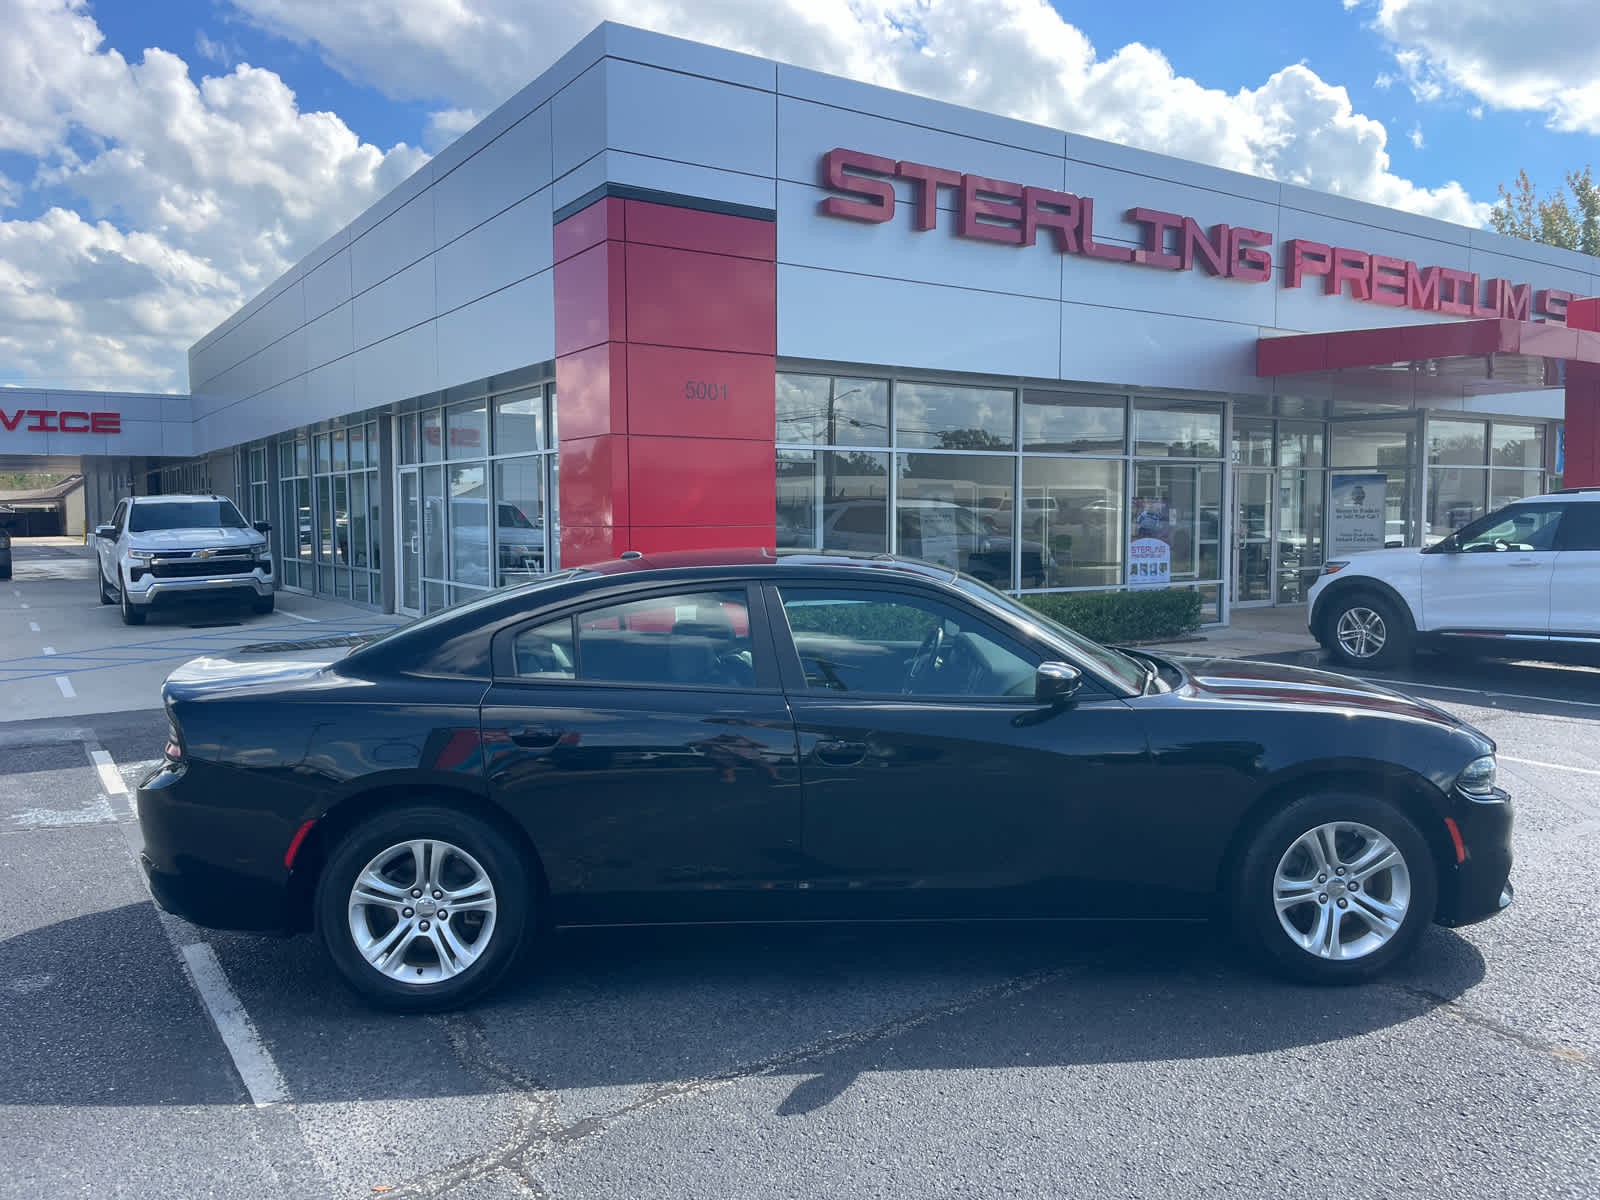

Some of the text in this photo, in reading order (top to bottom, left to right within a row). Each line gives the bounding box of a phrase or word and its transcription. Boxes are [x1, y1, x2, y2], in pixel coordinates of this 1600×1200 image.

[821, 147, 1584, 328] STERLING PREMIUM S
[685, 380, 727, 401] 5001
[0, 408, 121, 433] VICE
